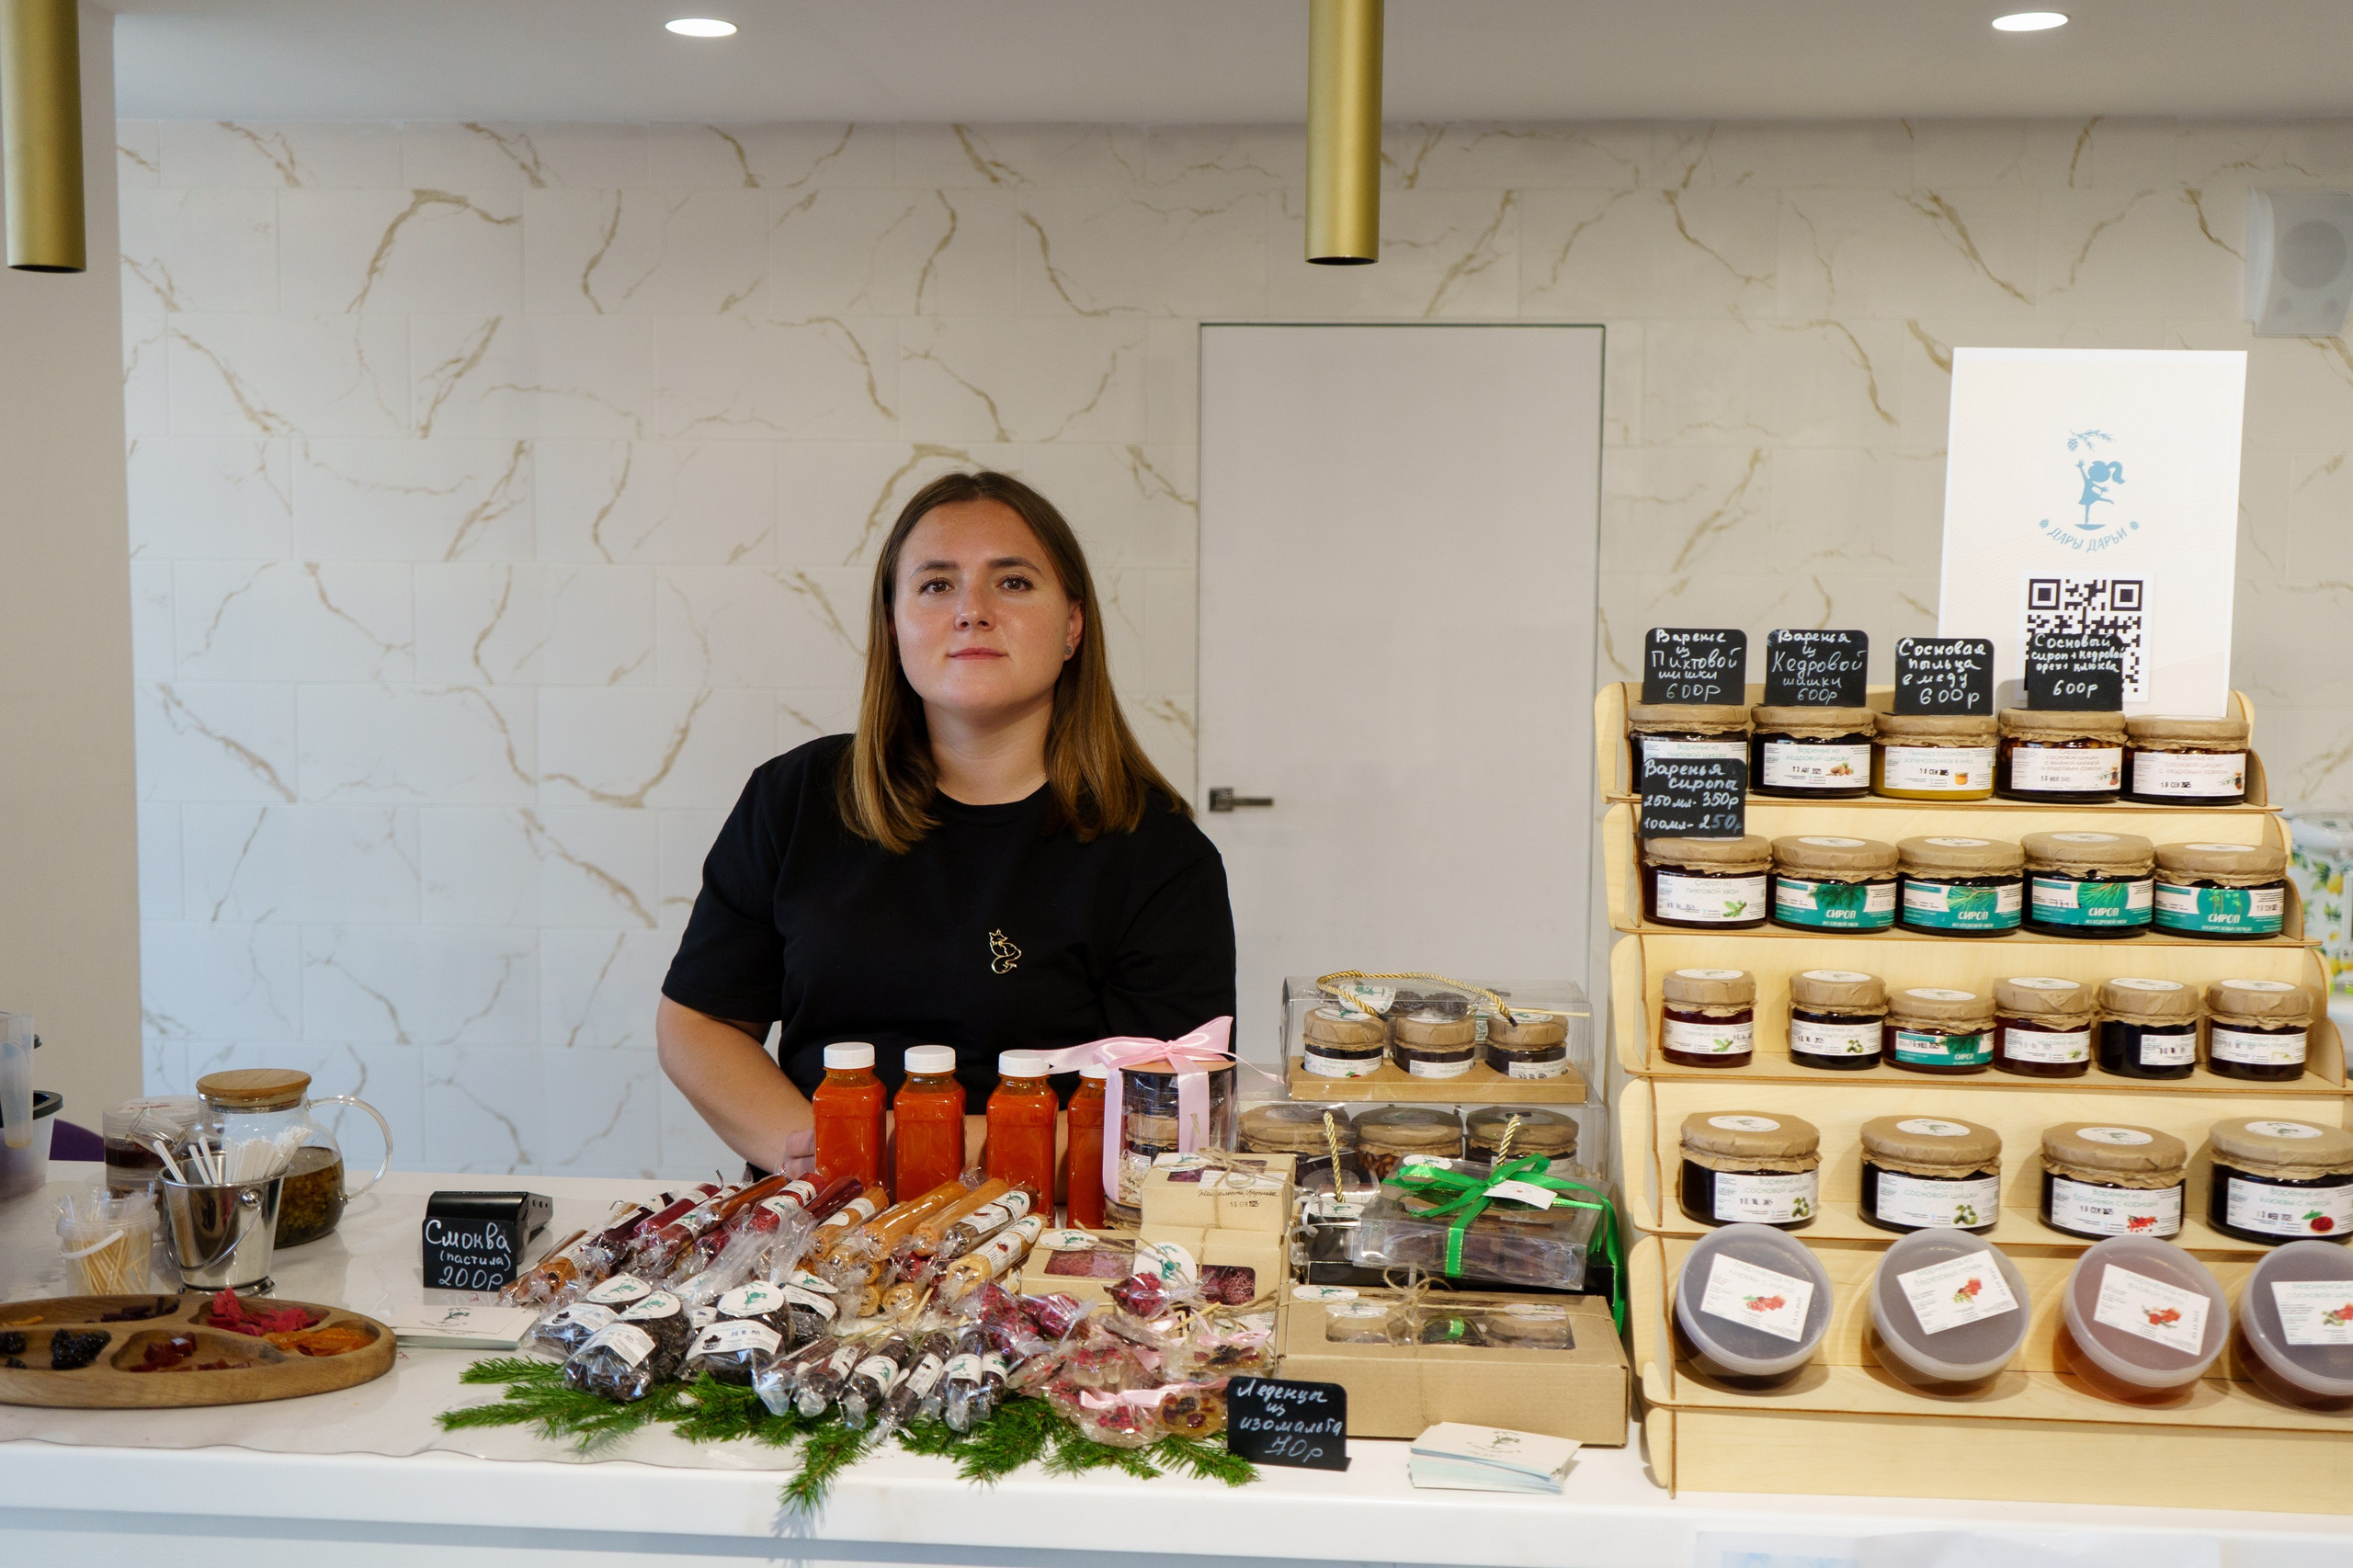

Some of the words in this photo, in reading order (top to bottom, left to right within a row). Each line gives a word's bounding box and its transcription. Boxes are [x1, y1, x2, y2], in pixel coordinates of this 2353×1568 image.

[2047, 527, 2083, 550] ДАРЫ
[2086, 528, 2128, 552] ДАРЬИ
[1898, 637, 1987, 656] Сосновая
[2033, 633, 2111, 650] Сосновый
[1676, 645, 1690, 657] из
[1651, 647, 1742, 670] Пихтовой
[1771, 650, 1867, 679] Кедровой
[1907, 657, 1982, 671] пыльца
[1658, 669, 1718, 680] шишки
[2073, 662, 2120, 674] клюква
[1782, 676, 1843, 687] шишки
[1916, 673, 1968, 688] меду
[1665, 683, 1722, 702] 600р
[2052, 679, 2098, 699] 600р
[1797, 688, 1838, 705] 600р
[1920, 687, 1981, 710] 600р
[1677, 743, 1711, 752] Варенье
[1797, 746, 1831, 755] Варенье
[1908, 749, 1936, 757] Пыльца
[1666, 751, 1701, 759] пихтовой
[1643, 758, 1727, 778] Варенья
[1702, 791, 1740, 811] 350р
[1694, 879, 1722, 888] Сироп
[1686, 887, 1722, 895] пихтовой
[1825, 909, 1857, 920] СИРОП
[1958, 910, 1989, 921] СИРОП
[2087, 906, 2120, 917] СИРОП
[2207, 913, 2241, 924] СИРОП
[1954, 1052, 1975, 1061] СИРОП
[1758, 1177, 1794, 1186] Варенье
[1922, 1181, 1953, 1190] Сироп
[1745, 1186, 1786, 1194] сосновой
[1904, 1189, 1949, 1199] сосновой
[425, 1219, 512, 1254] Смоква
[439, 1250, 512, 1272] (пастила)
[438, 1266, 504, 1291] 200р
[1236, 1379, 1328, 1405] Леденцы
[1265, 1402, 1286, 1417] из
[1239, 1416, 1344, 1437] изомальта
